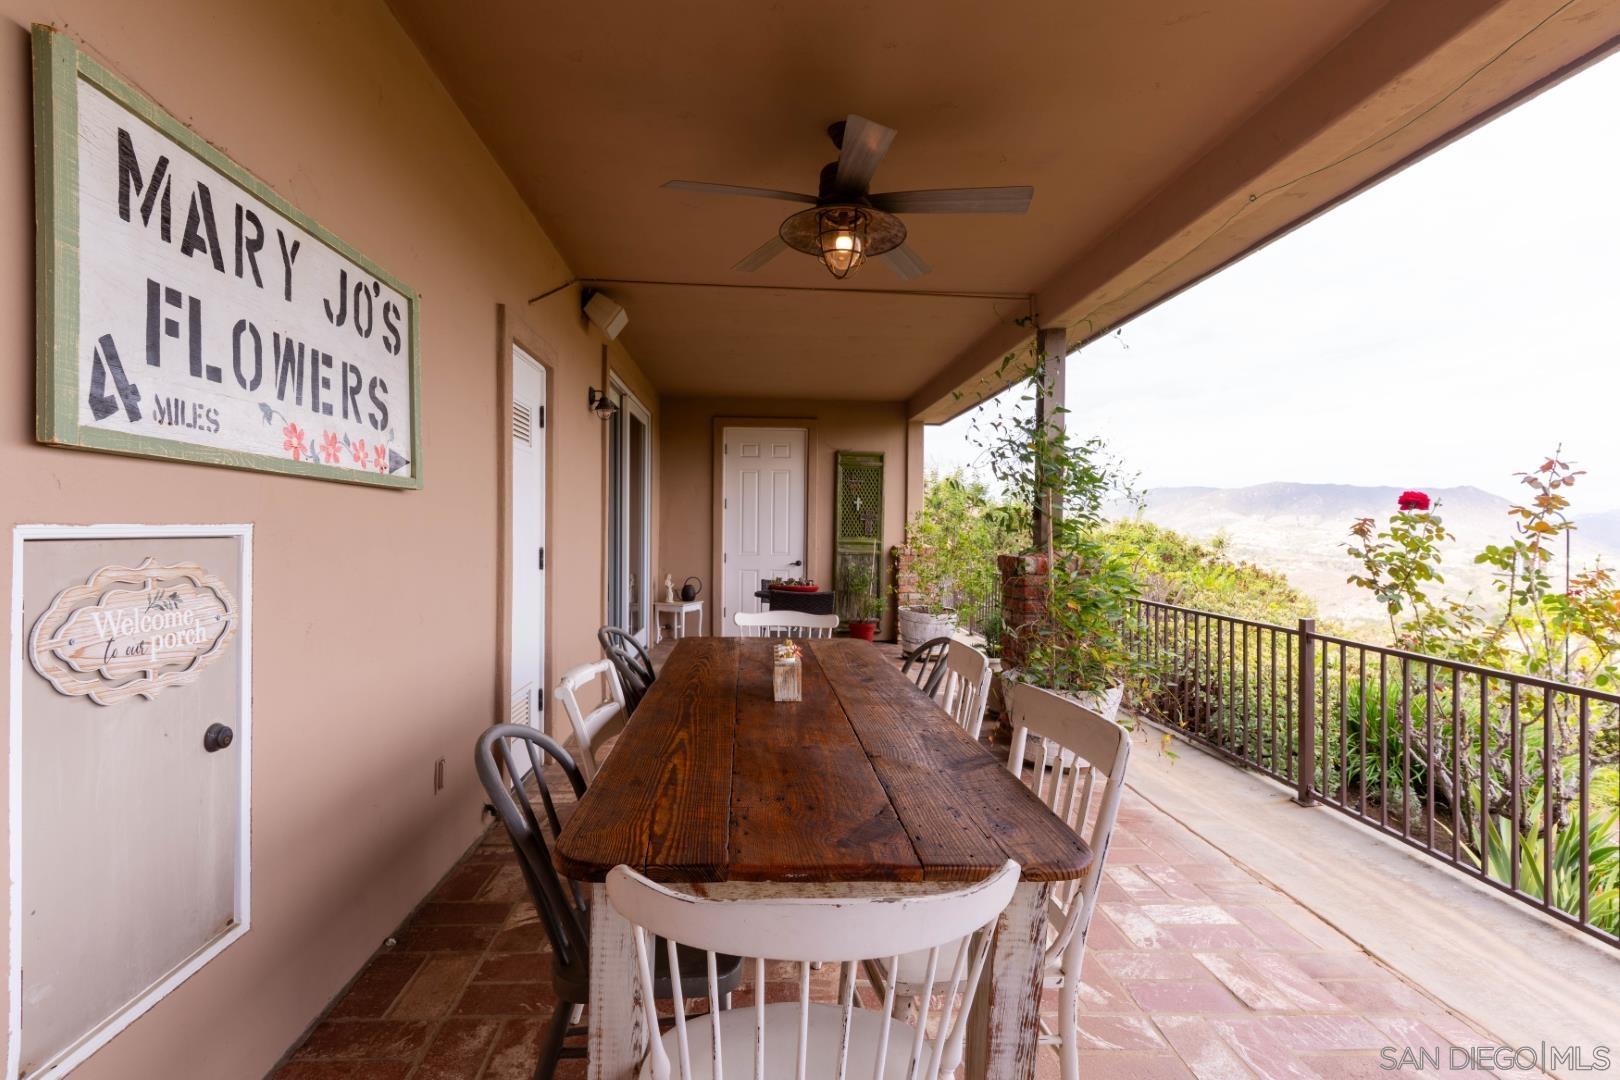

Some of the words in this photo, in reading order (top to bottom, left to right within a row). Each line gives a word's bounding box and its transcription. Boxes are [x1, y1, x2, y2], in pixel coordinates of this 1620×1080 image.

[117, 127, 300, 302] MARY
[322, 268, 402, 356] JO'S
[88, 333, 142, 423] 4
[153, 392, 220, 434] MILES
[146, 277, 390, 432] FLOWERS
[91, 608, 195, 639] Welcome
[103, 637, 118, 664] to
[125, 640, 146, 656] our
[150, 619, 207, 661] porch
